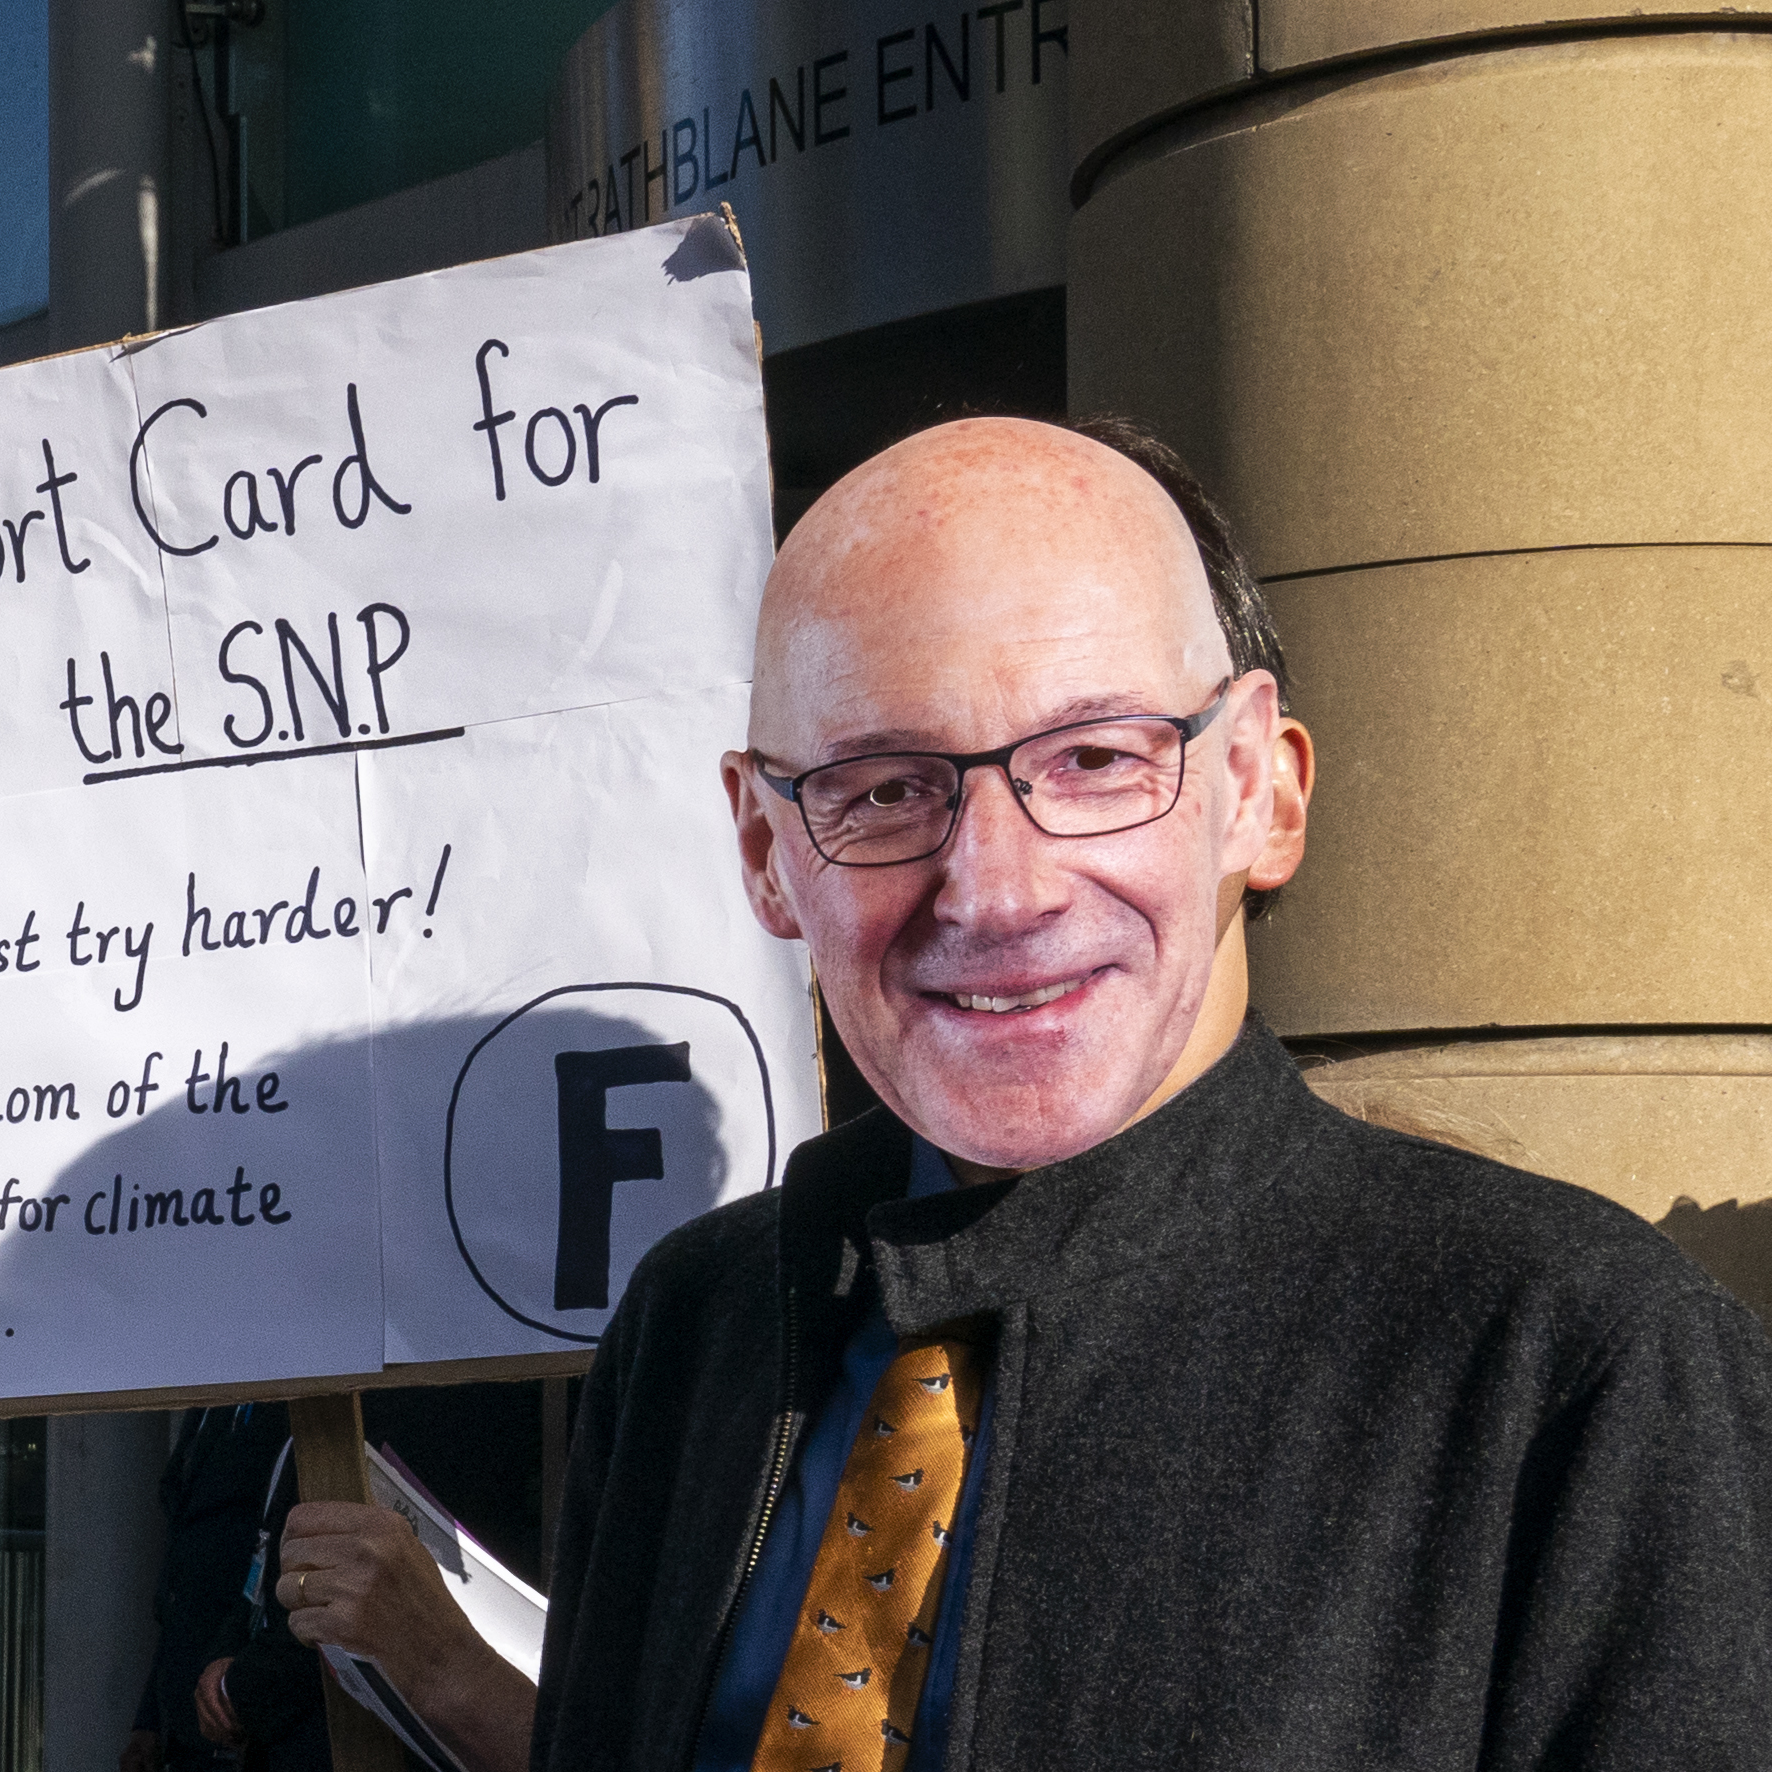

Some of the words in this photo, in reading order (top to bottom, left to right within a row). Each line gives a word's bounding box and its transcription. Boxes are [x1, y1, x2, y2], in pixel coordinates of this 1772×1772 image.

[564, 51, 850, 237] TRATHBLANE
[131, 384, 411, 555] Card
[473, 339, 639, 499] for
[62, 653, 185, 767] the
[219, 603, 411, 747] S.N.P
[66, 901, 150, 1011] try
[182, 844, 452, 958] harder!
[108, 1052, 165, 1120] of
[185, 1042, 290, 1117] the
[84, 1166, 292, 1236] climate
[553, 1041, 691, 1311] F
